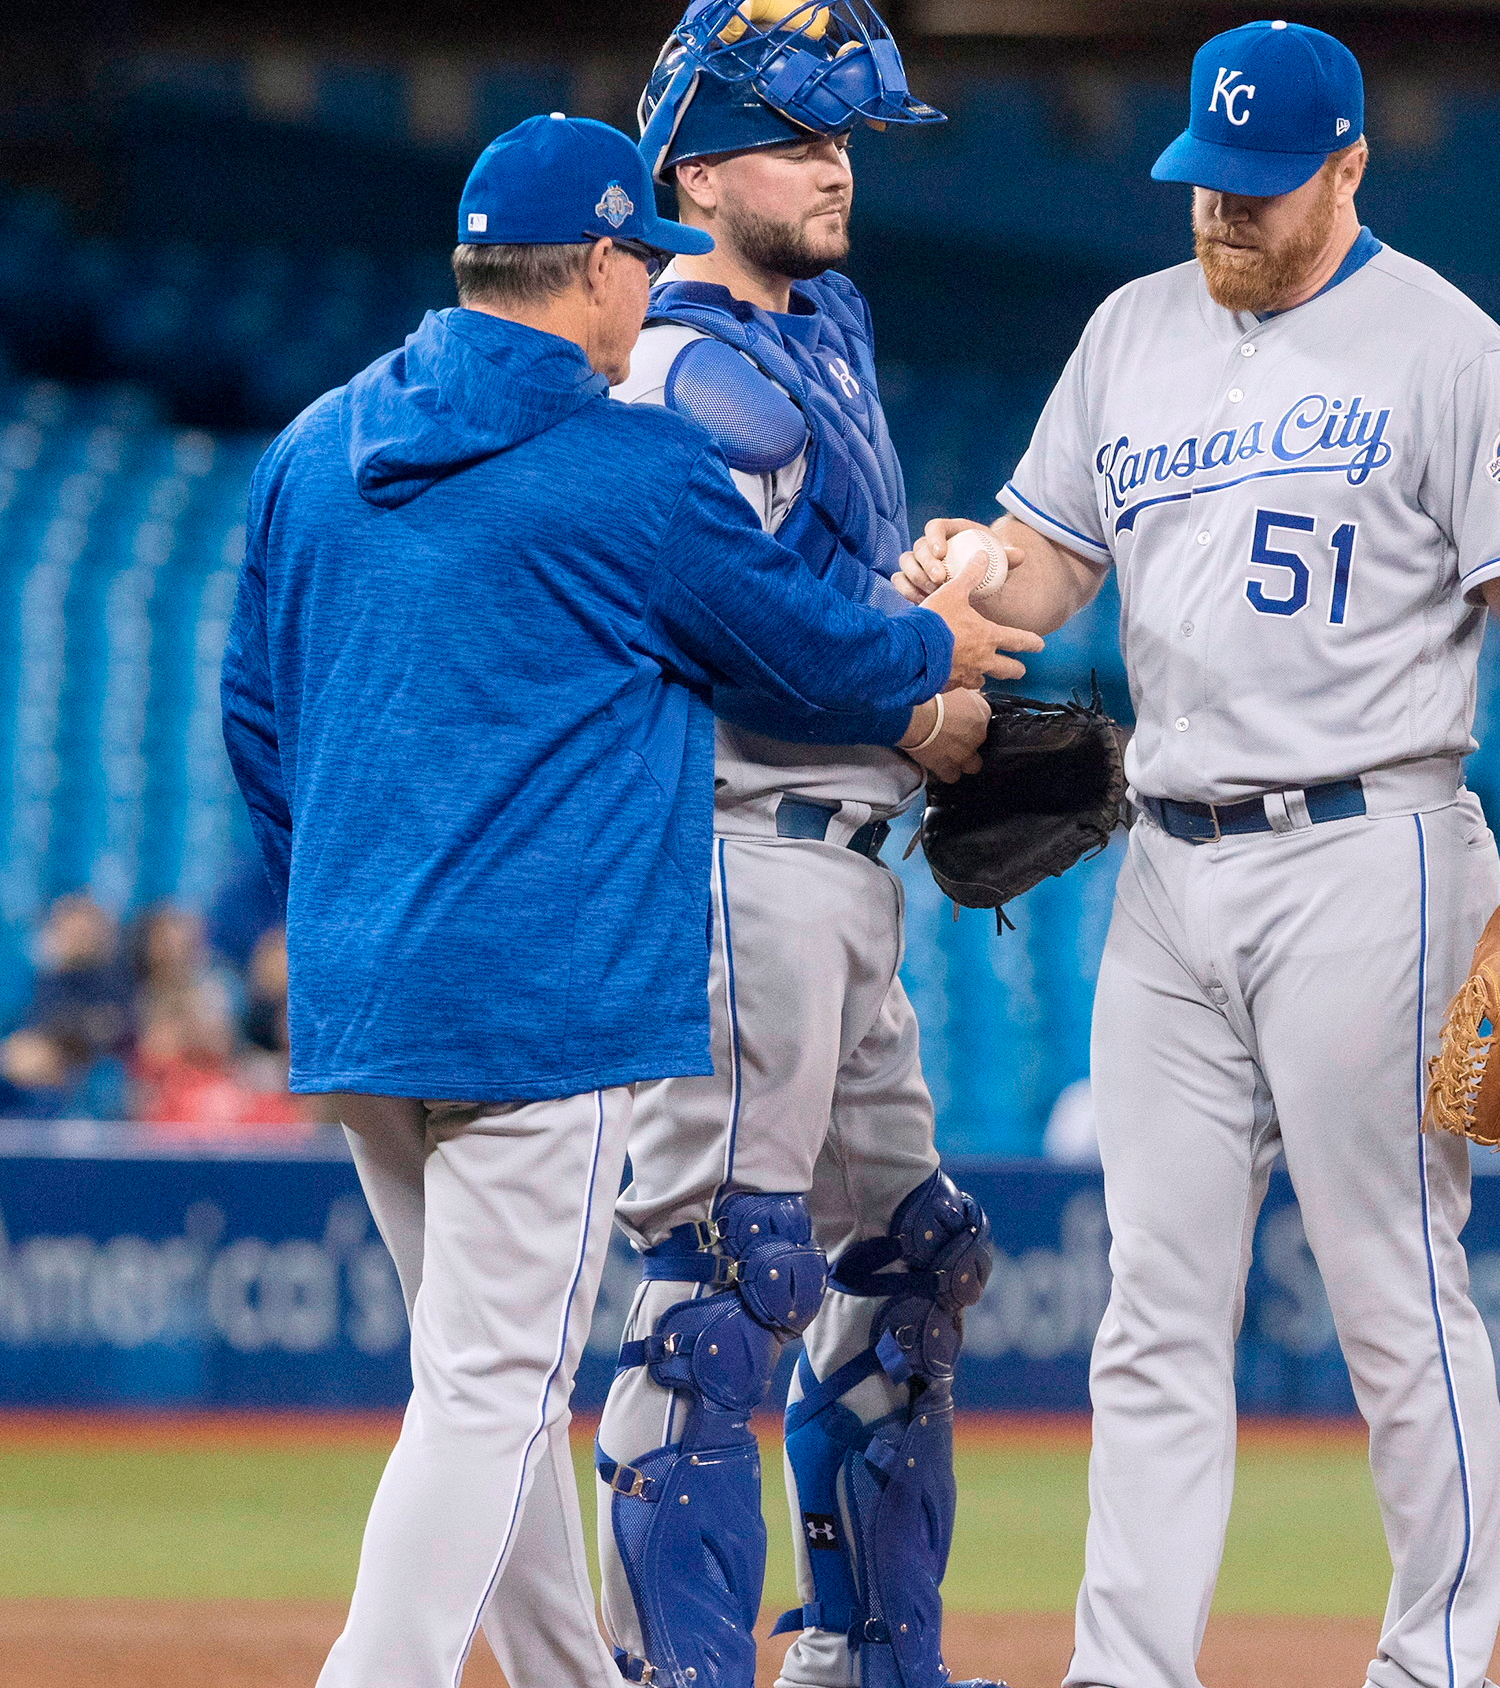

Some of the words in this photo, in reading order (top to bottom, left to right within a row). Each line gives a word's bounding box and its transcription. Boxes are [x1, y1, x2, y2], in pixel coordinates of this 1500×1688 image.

[1208, 67, 1256, 126] KC
[1092, 419, 1267, 520] Kansas
[1270, 391, 1393, 487] City
[1243, 505, 1359, 628] 51
